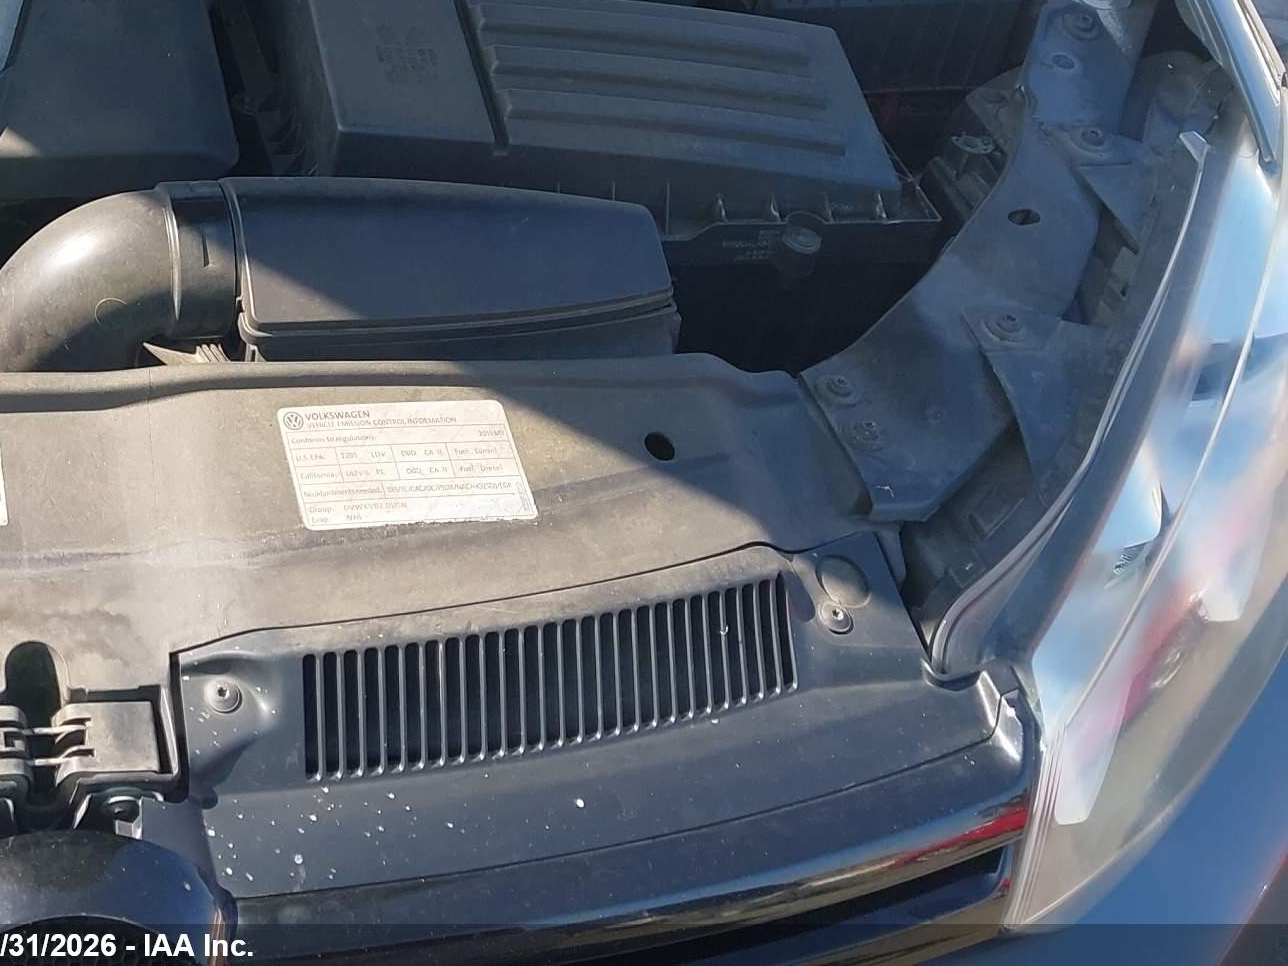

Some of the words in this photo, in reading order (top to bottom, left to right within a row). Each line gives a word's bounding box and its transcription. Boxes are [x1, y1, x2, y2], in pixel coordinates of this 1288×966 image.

[304, 410, 370, 421] VOLKSWAGEN
[337, 419, 372, 428] EMISSION
[373, 418, 406, 426] CONTROL
[407, 416, 457, 425] INFORMATION
